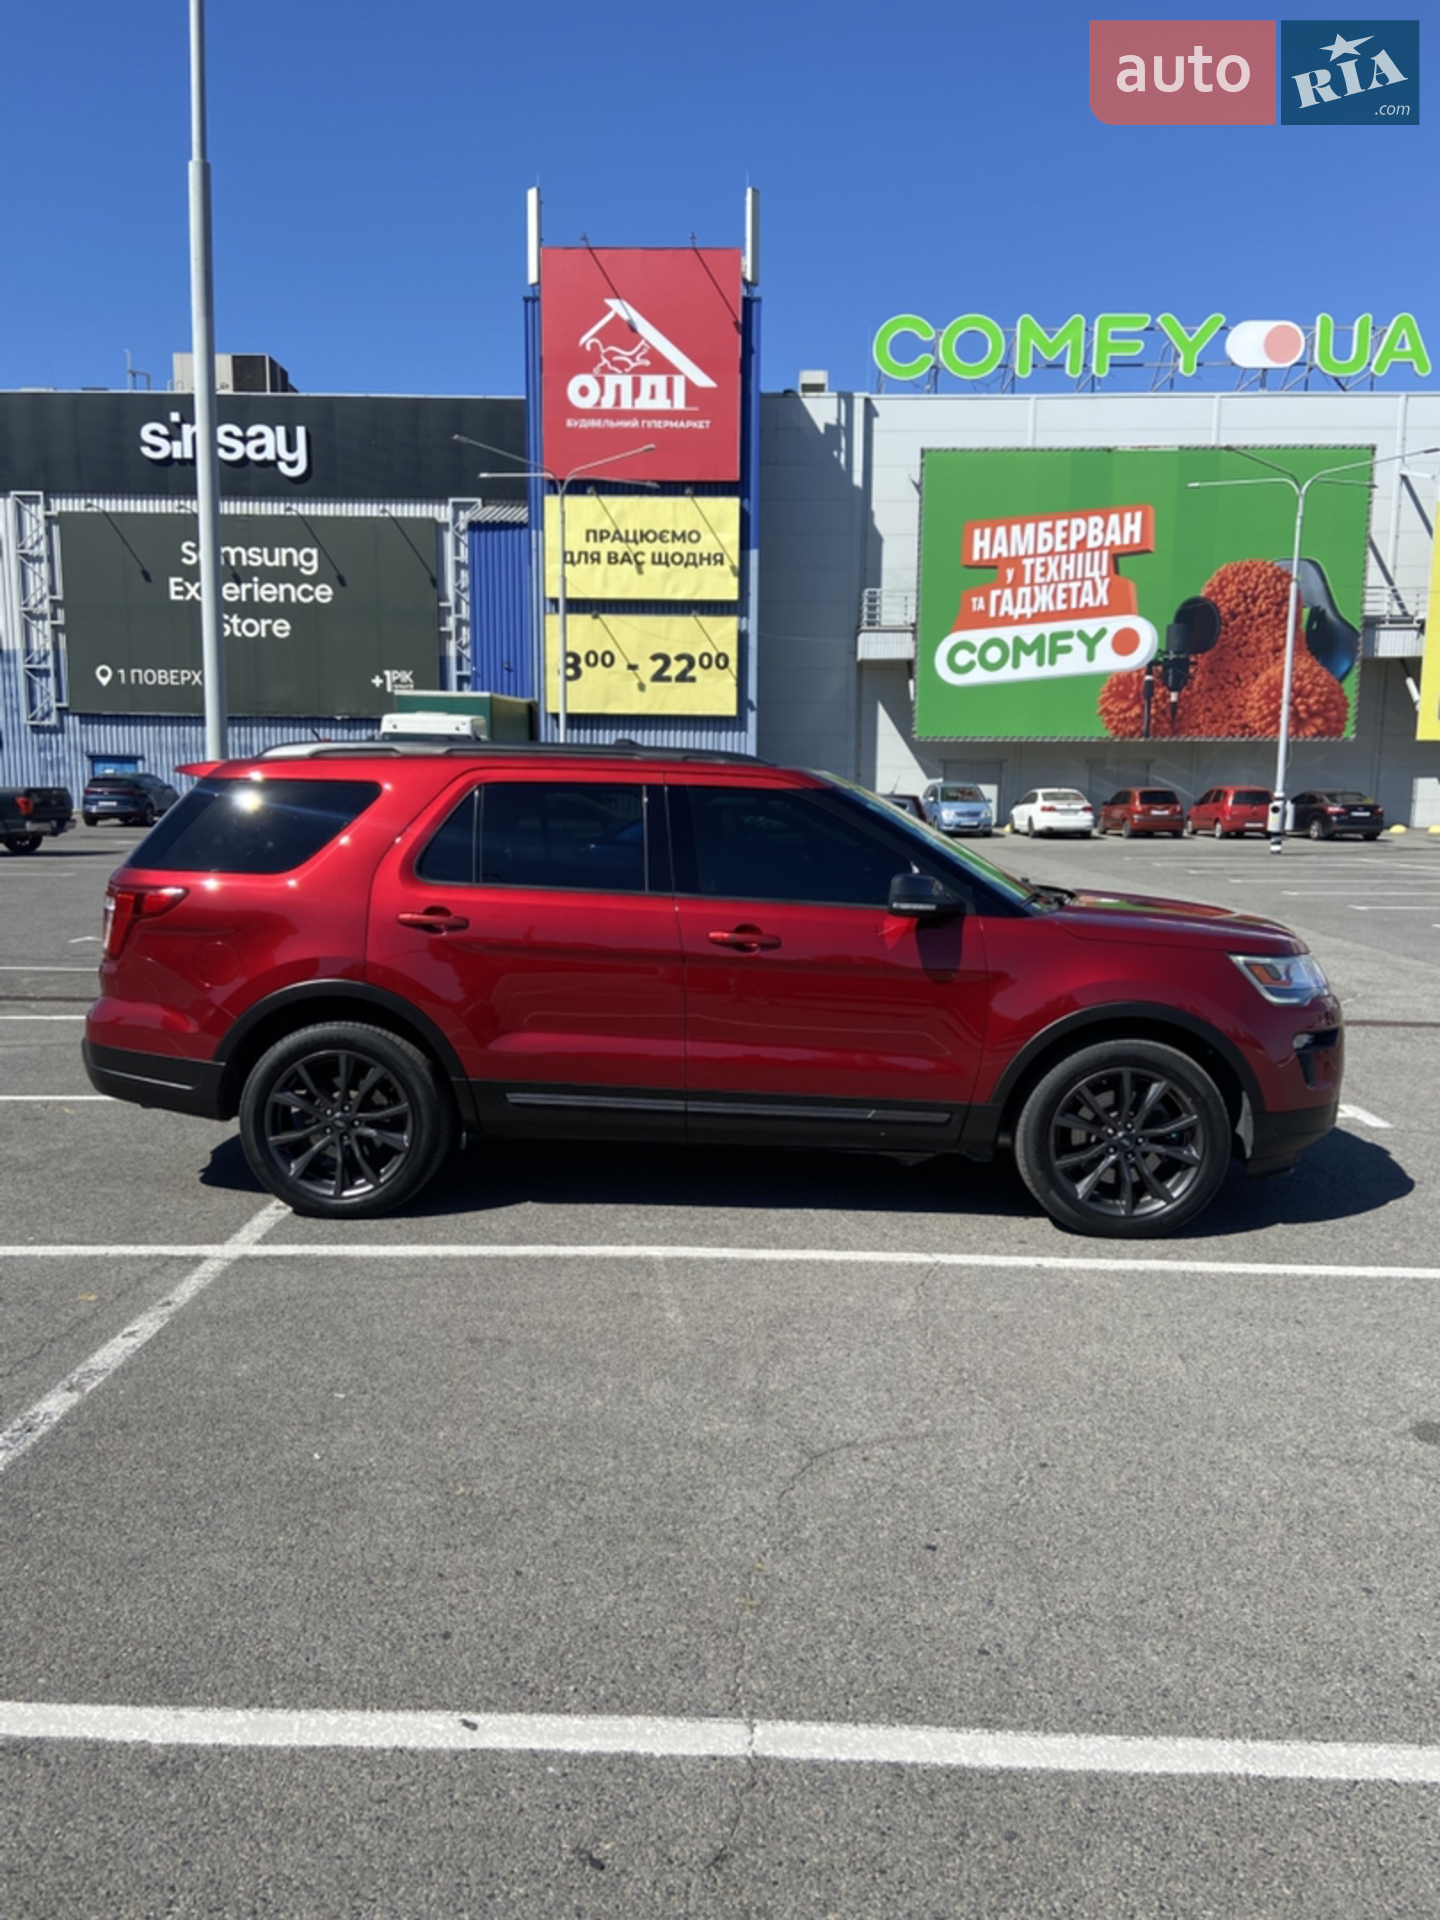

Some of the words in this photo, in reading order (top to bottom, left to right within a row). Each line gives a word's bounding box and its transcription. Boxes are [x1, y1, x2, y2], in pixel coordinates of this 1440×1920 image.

[873, 314, 1225, 379] COMFY
[1315, 313, 1431, 377] UA
[567, 373, 686, 409] ОЛДІ
[585, 529, 702, 545] ПРАЦЮЄМО
[972, 511, 1142, 561] НАМБЕРВАН
[181, 541, 319, 575] Smsung
[563, 551, 601, 566] ДЛЯ
[607, 551, 645, 566] ВАС
[651, 551, 725, 568] ЩОДНЯ
[1021, 550, 1110, 585] ТЕХНІЦІ
[168, 576, 333, 603] Exerience
[988, 577, 1110, 619] ГАДЖЕТАХ
[946, 627, 1108, 675] COMFY
[117, 669, 125, 684] 1
[131, 669, 203, 685] ПОВЕРХ
